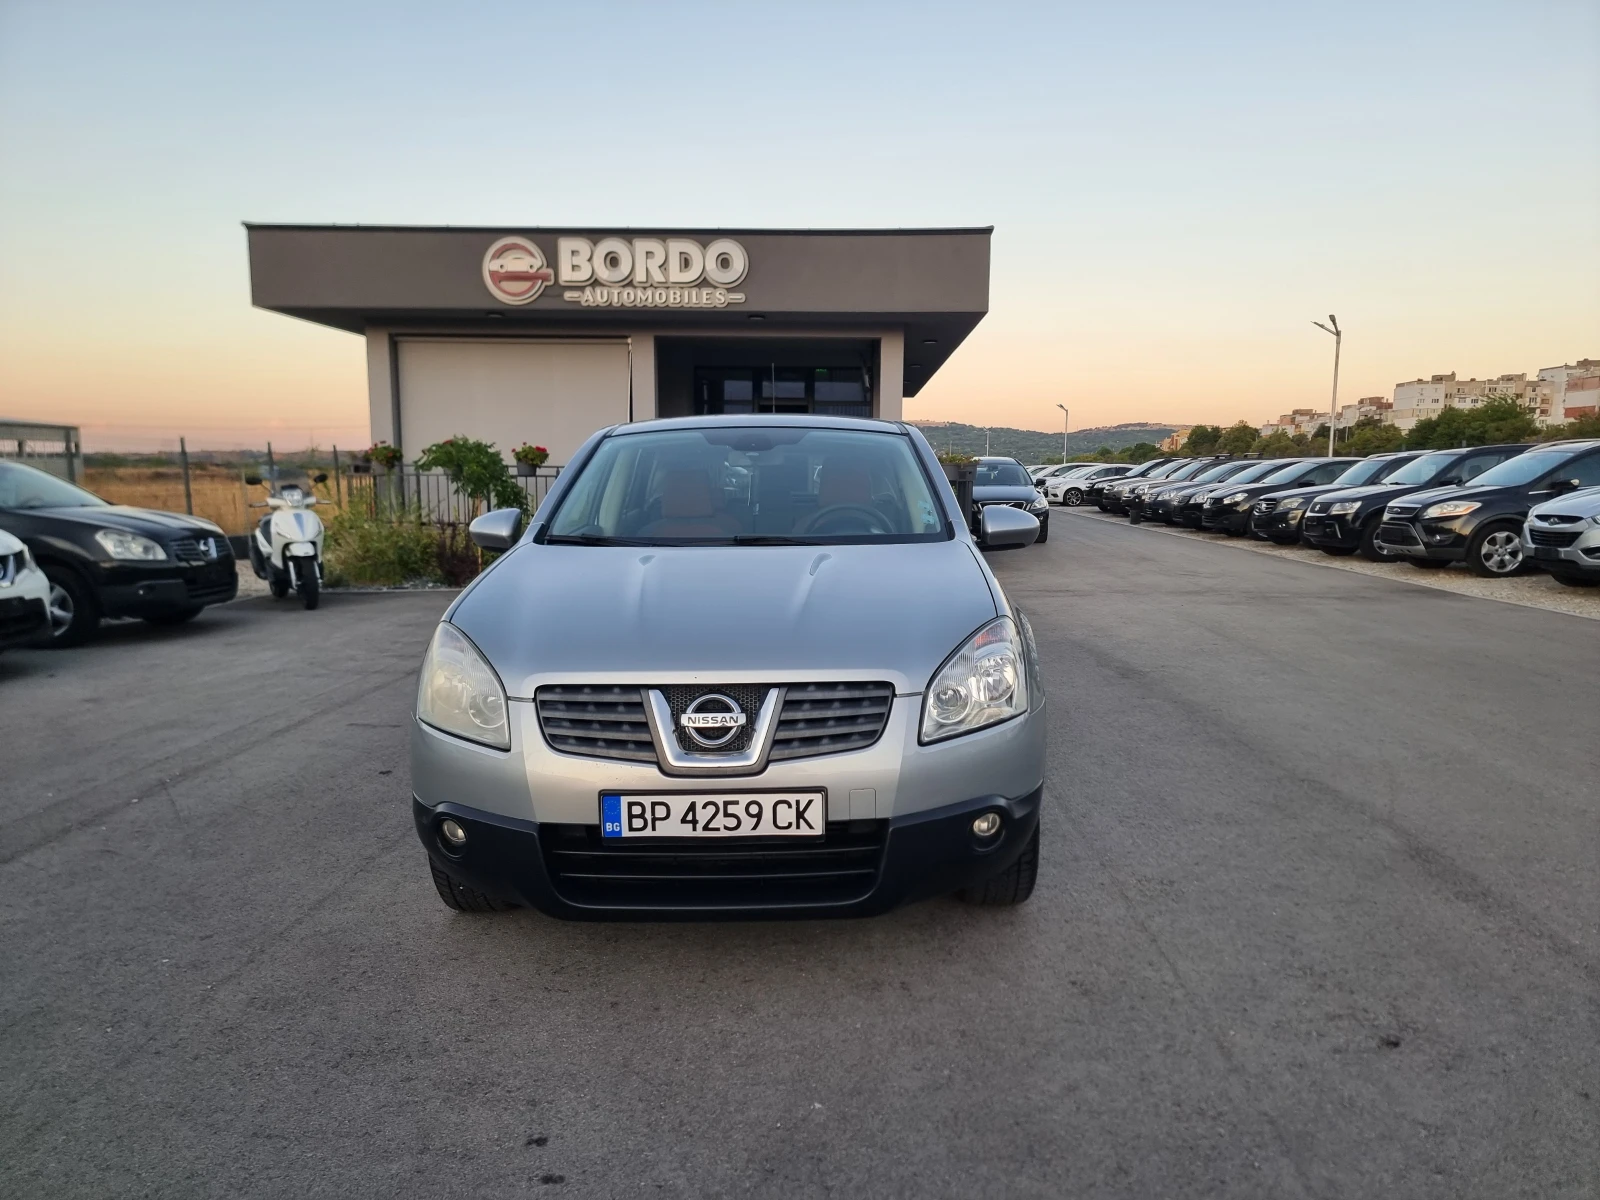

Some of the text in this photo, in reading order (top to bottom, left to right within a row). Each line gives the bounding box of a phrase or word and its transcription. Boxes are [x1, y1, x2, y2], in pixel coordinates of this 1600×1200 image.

[559, 238, 746, 285] BORDO
[582, 287, 726, 304] AUTOMOBILES
[687, 715, 739, 726] NISSAN
[627, 799, 816, 832] BP 4259 CK
[605, 822, 621, 832] BG
